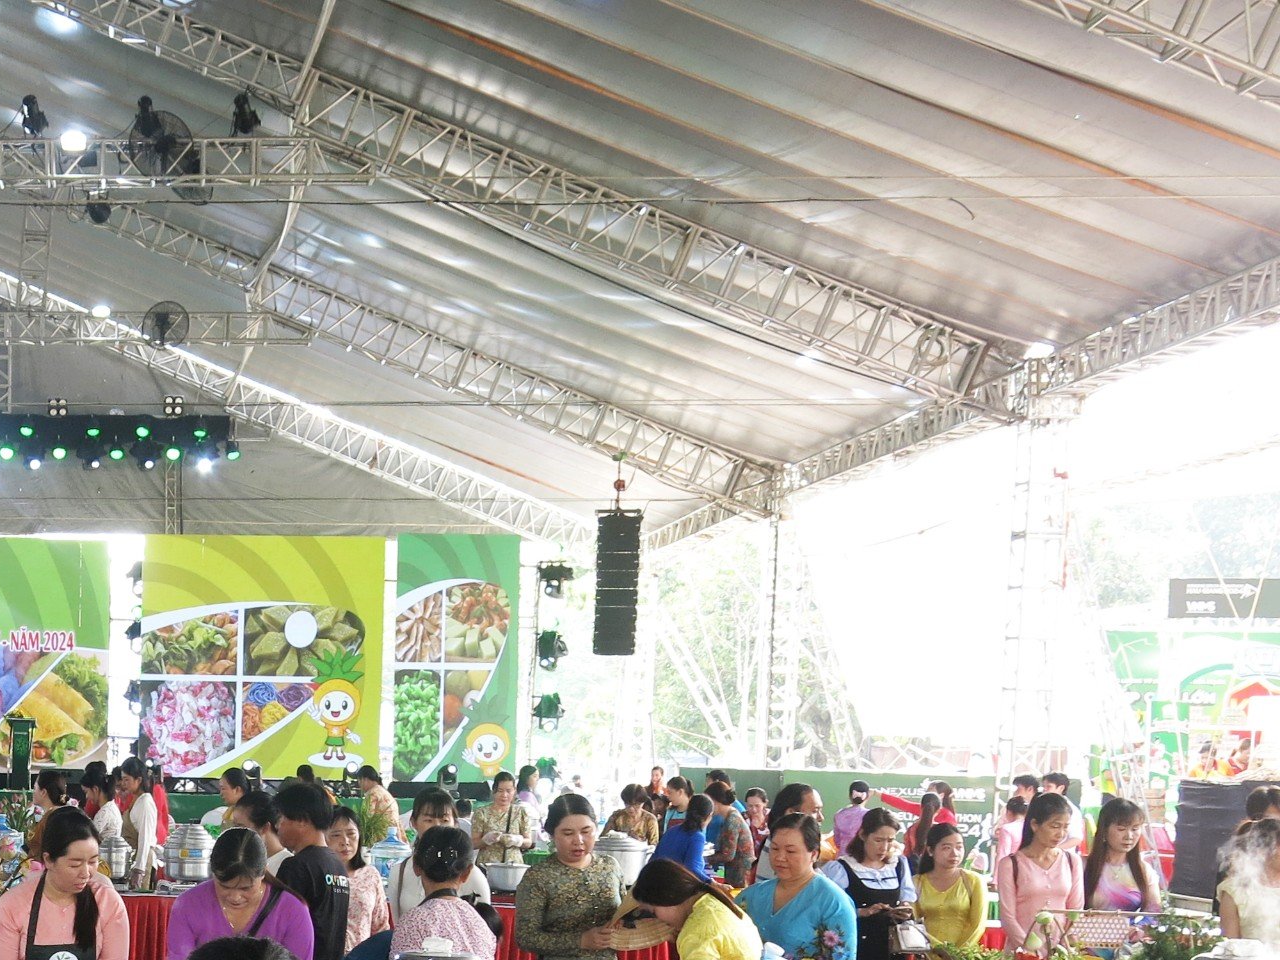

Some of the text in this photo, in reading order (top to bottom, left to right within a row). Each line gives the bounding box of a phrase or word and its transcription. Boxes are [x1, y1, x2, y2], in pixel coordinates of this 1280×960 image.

[11, 626, 40, 651] NĂM
[44, 631, 75, 652] 2024
[880, 787, 926, 796] NEXUS
[957, 823, 981, 838] 24
